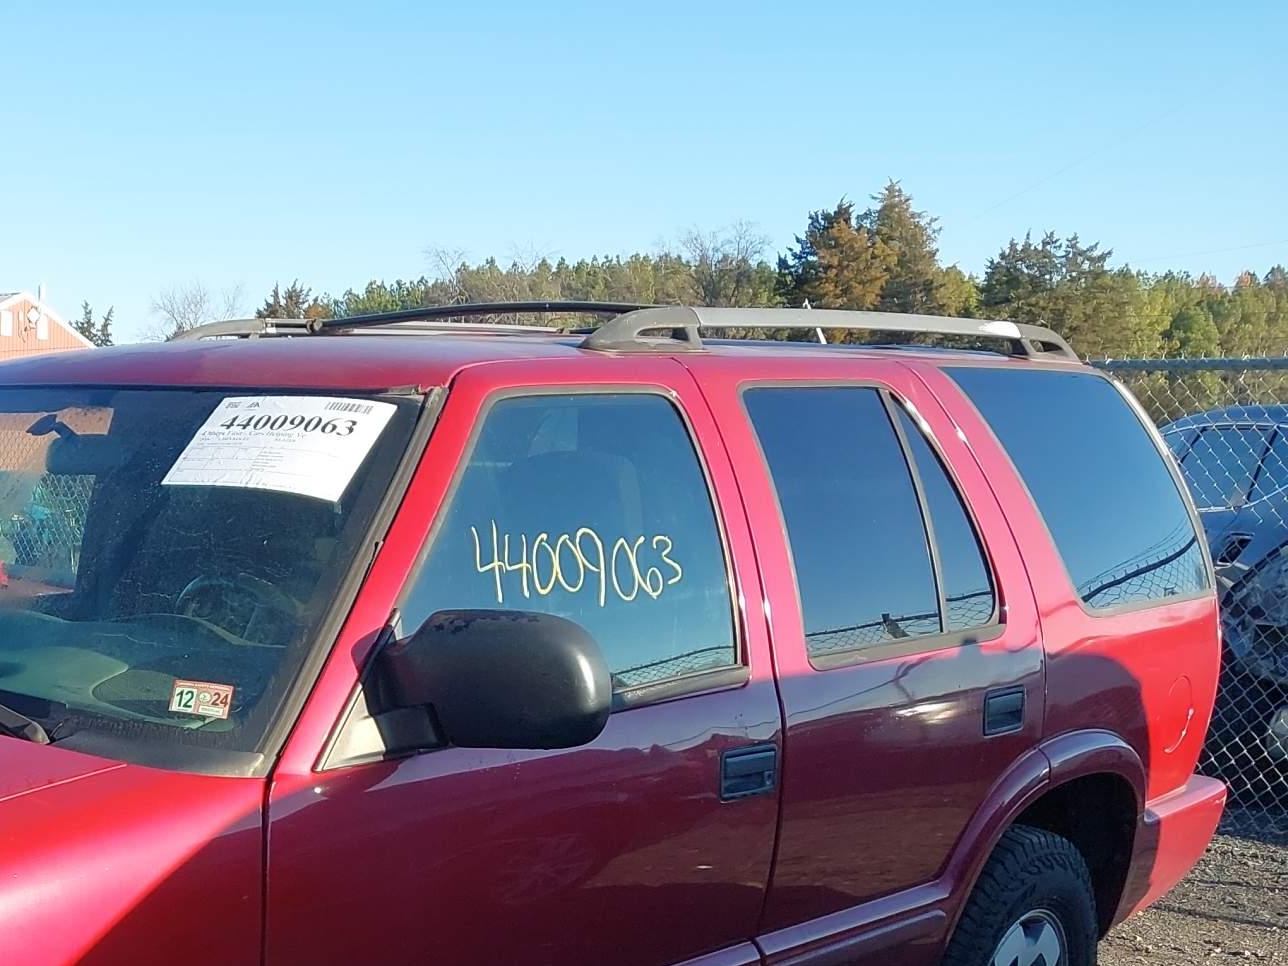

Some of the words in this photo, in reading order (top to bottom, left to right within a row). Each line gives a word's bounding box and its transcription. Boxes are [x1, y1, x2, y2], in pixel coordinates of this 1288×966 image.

[220, 414, 358, 436] 44009063
[471, 519, 682, 607] 44009063
[176, 689, 195, 708] 12
[211, 692, 230, 708] 24
